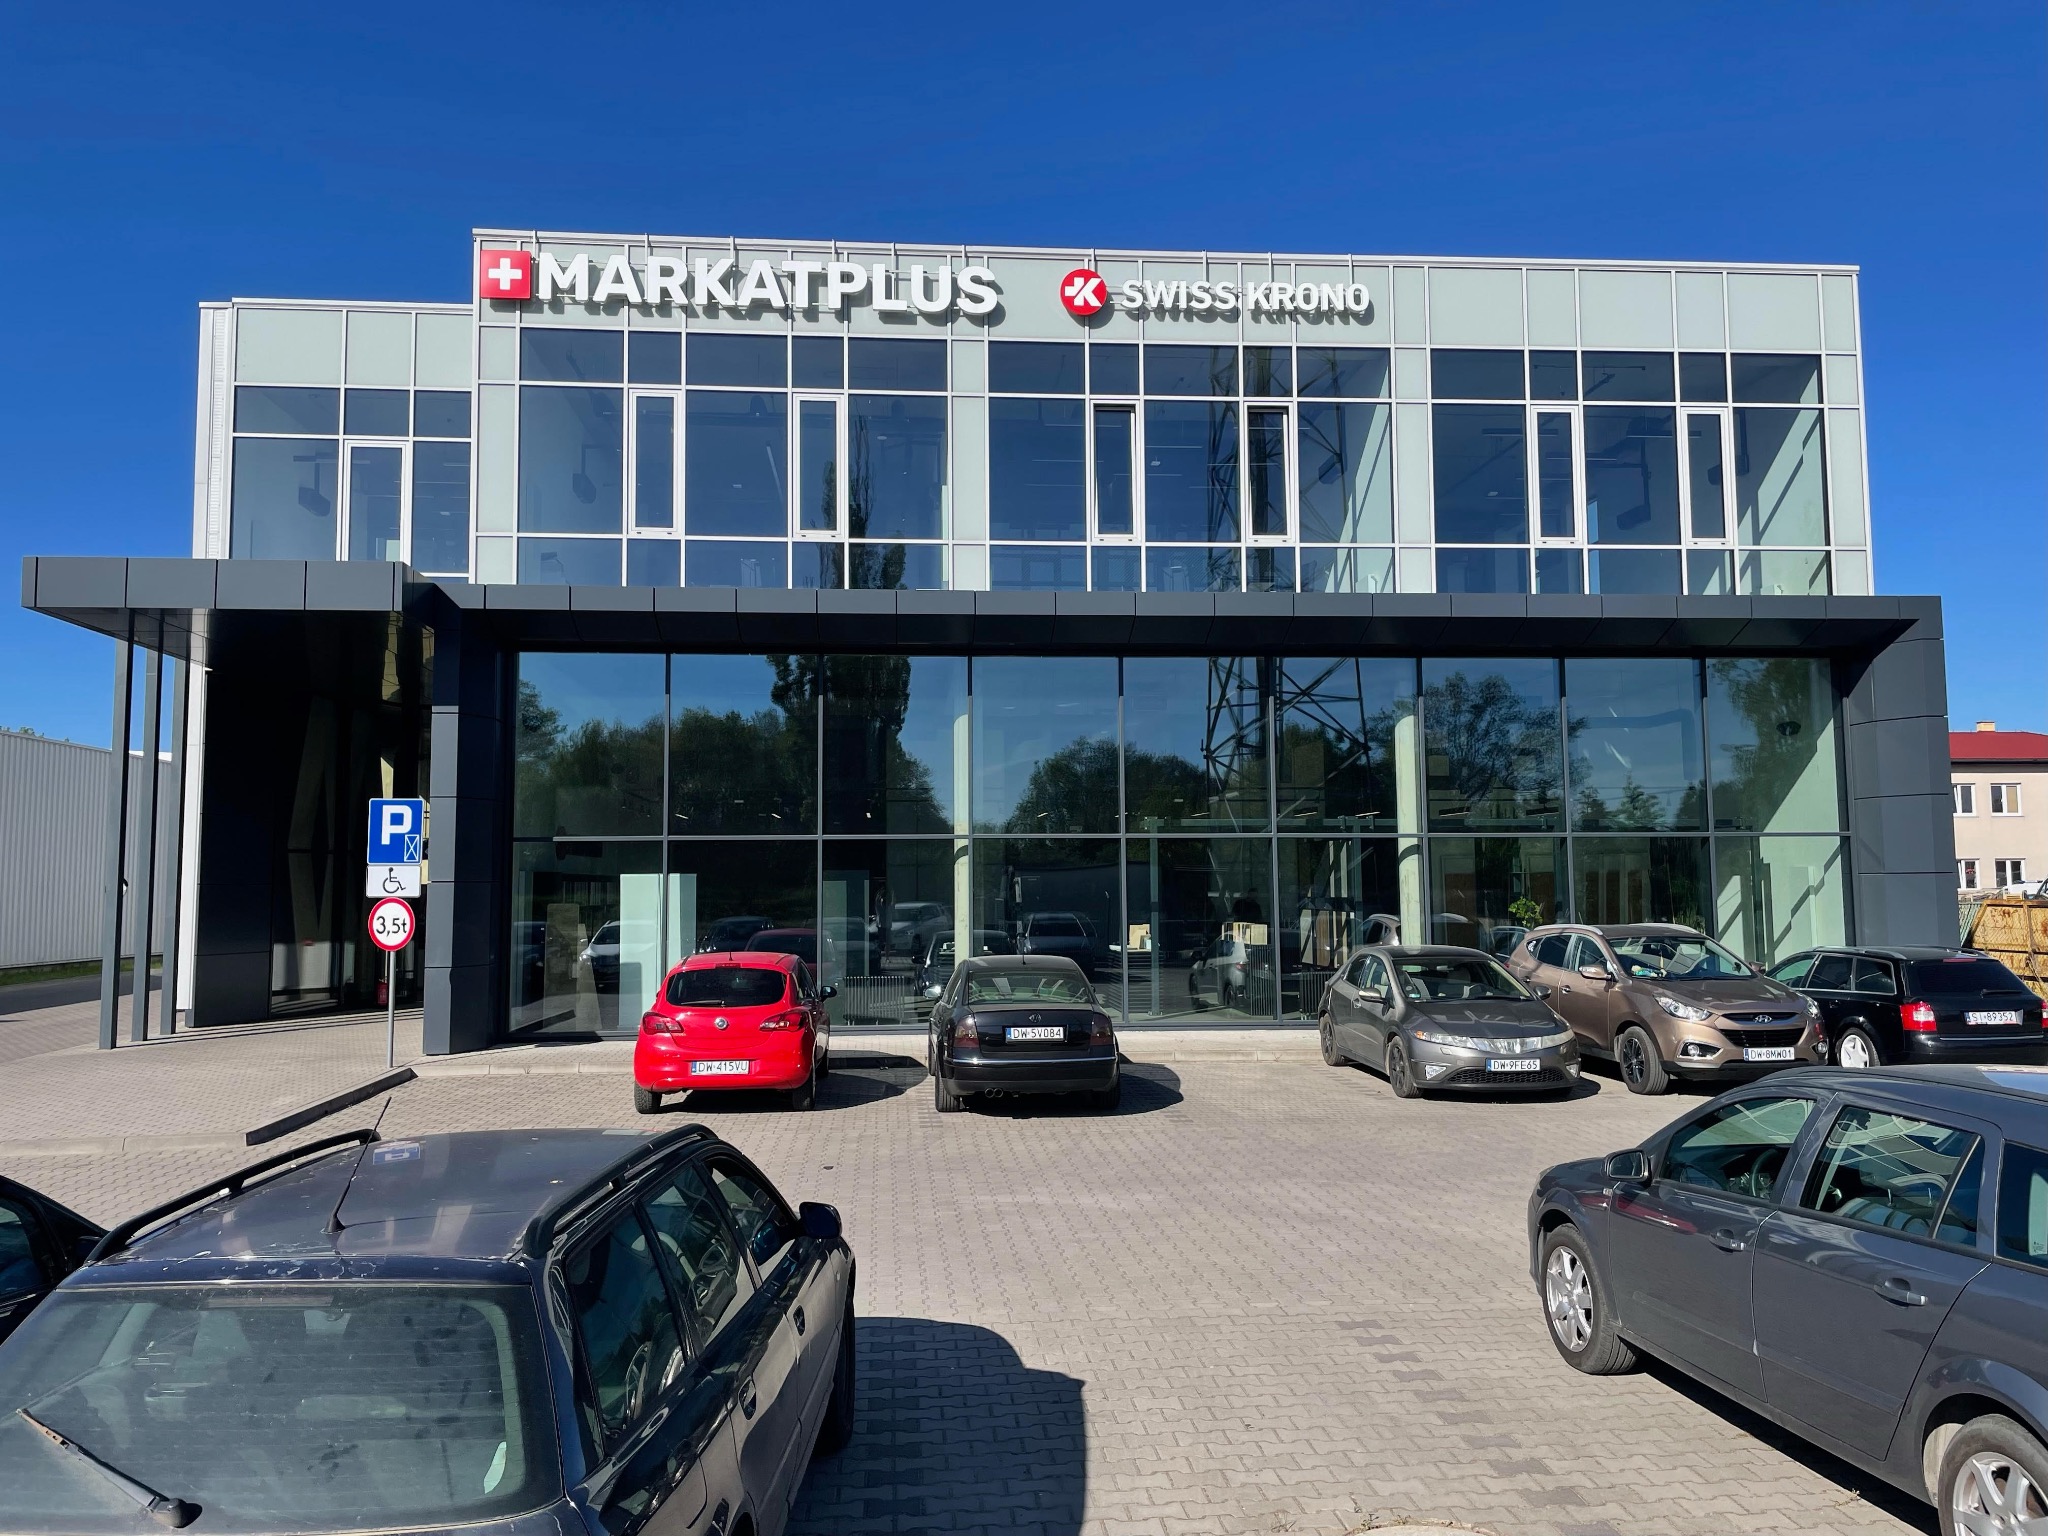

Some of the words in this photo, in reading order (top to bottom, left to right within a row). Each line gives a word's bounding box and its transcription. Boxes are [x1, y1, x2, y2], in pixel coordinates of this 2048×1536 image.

[539, 252, 998, 315] MARKATPLUS
[1121, 279, 1237, 310] SWISS
[1247, 281, 1371, 312] KRONO
[381, 805, 412, 845] P
[376, 916, 408, 937] 3,5t
